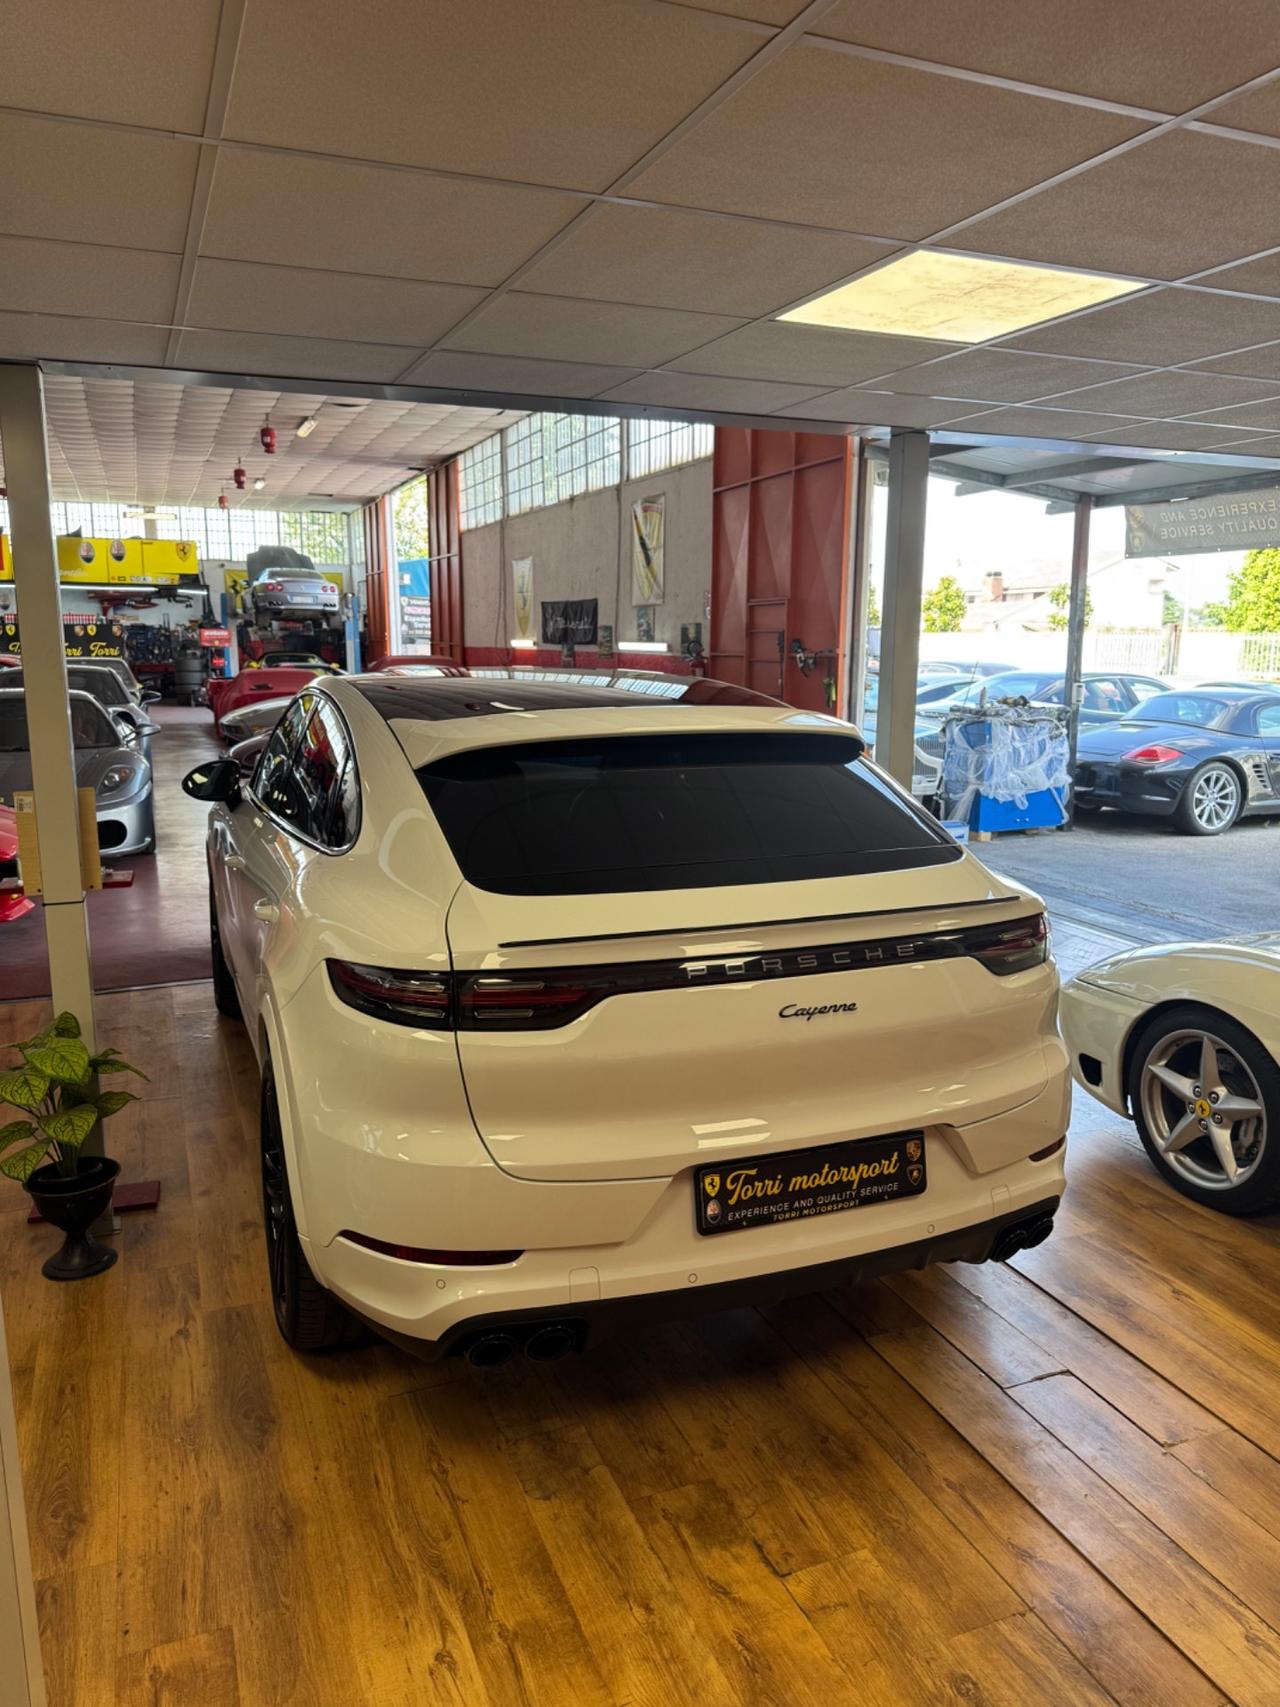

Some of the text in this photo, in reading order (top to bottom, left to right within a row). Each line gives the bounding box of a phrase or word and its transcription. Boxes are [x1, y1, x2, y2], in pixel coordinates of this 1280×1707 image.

[89, 641, 120, 657] Torri
[687, 943, 915, 980] PORSCHE
[778, 1001, 858, 1021] Cayenne
[726, 1151, 899, 1206] Torri motorsport
[727, 1182, 900, 1222] EXPERIENCE AND QUALITY SERVICE
[773, 1199, 860, 1222] TORRI MOTORSPORT
